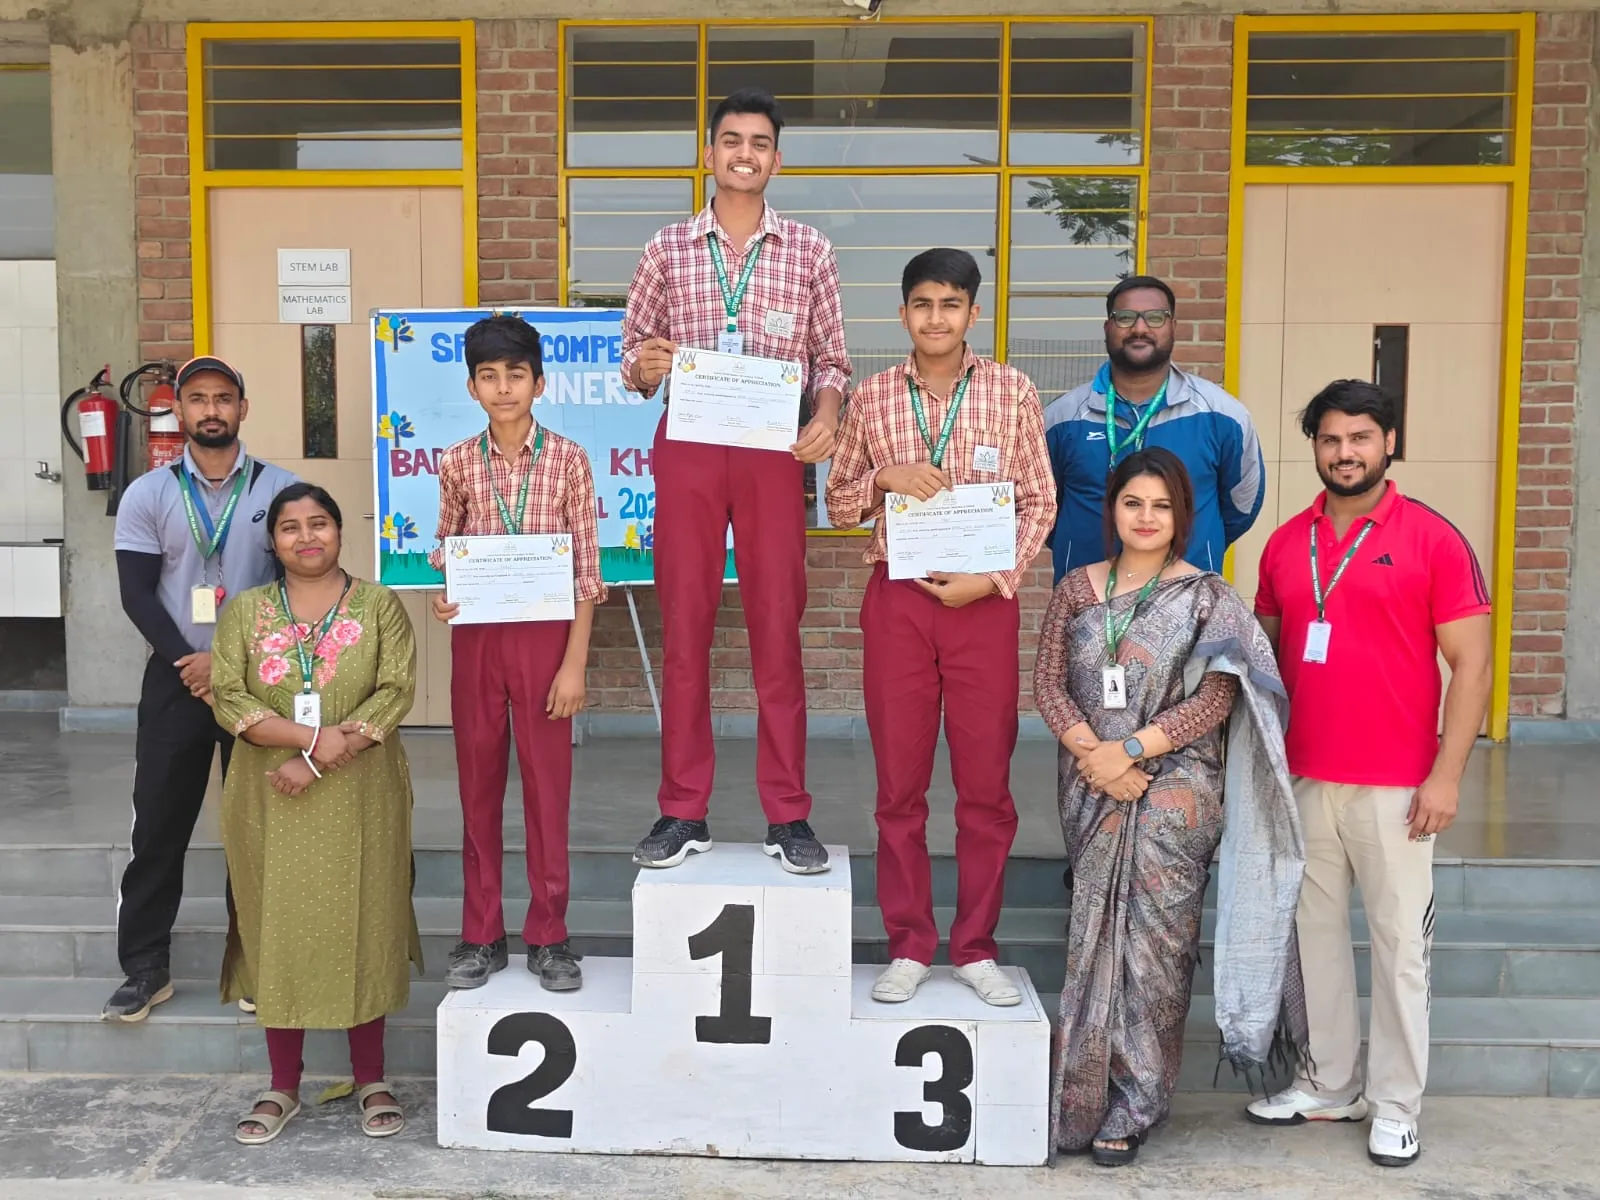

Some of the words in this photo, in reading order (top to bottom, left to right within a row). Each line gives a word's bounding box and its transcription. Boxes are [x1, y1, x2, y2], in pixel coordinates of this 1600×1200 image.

[290, 263, 317, 272] STEM
[320, 263, 338, 272] LAB
[283, 296, 346, 304] MATHEMATICS
[306, 306, 324, 314] LAB
[431, 332, 465, 363] SP
[541, 334, 623, 363] COMPE
[390, 448, 443, 477] BAD
[610, 448, 655, 476] KH
[618, 487, 656, 519] 202
[688, 904, 771, 1044] 1
[487, 1012, 576, 1138] 2
[894, 1024, 974, 1151] 3
